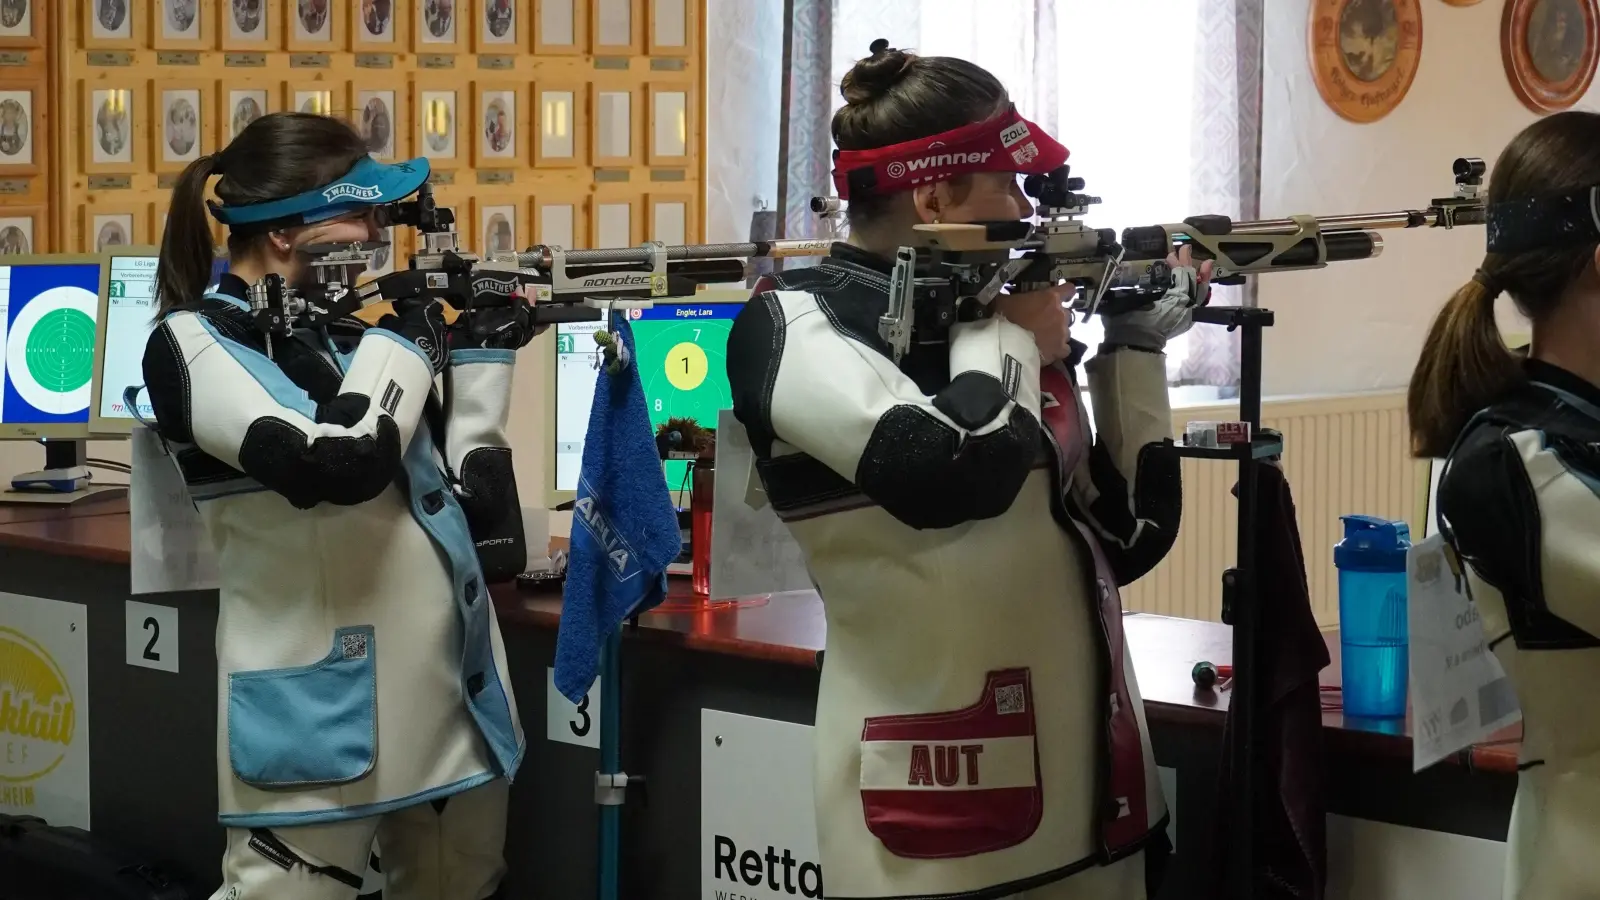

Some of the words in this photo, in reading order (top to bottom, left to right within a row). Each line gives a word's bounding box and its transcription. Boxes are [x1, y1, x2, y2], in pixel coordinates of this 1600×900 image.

[1002, 126, 1027, 143] ZOLL
[906, 151, 991, 171] winner
[331, 186, 374, 198] WALTHER
[476, 280, 515, 293] WALTHER
[583, 274, 652, 287] monotec
[676, 308, 698, 318] Engler,
[698, 308, 713, 316] Lara
[692, 328, 701, 342] 7
[681, 357, 689, 374] 1
[654, 398, 663, 412] 8
[476, 537, 514, 547] SPORTS
[143, 616, 160, 661] 2
[569, 694, 591, 737] 3
[908, 744, 983, 787] AUT
[714, 834, 824, 900] Retta
